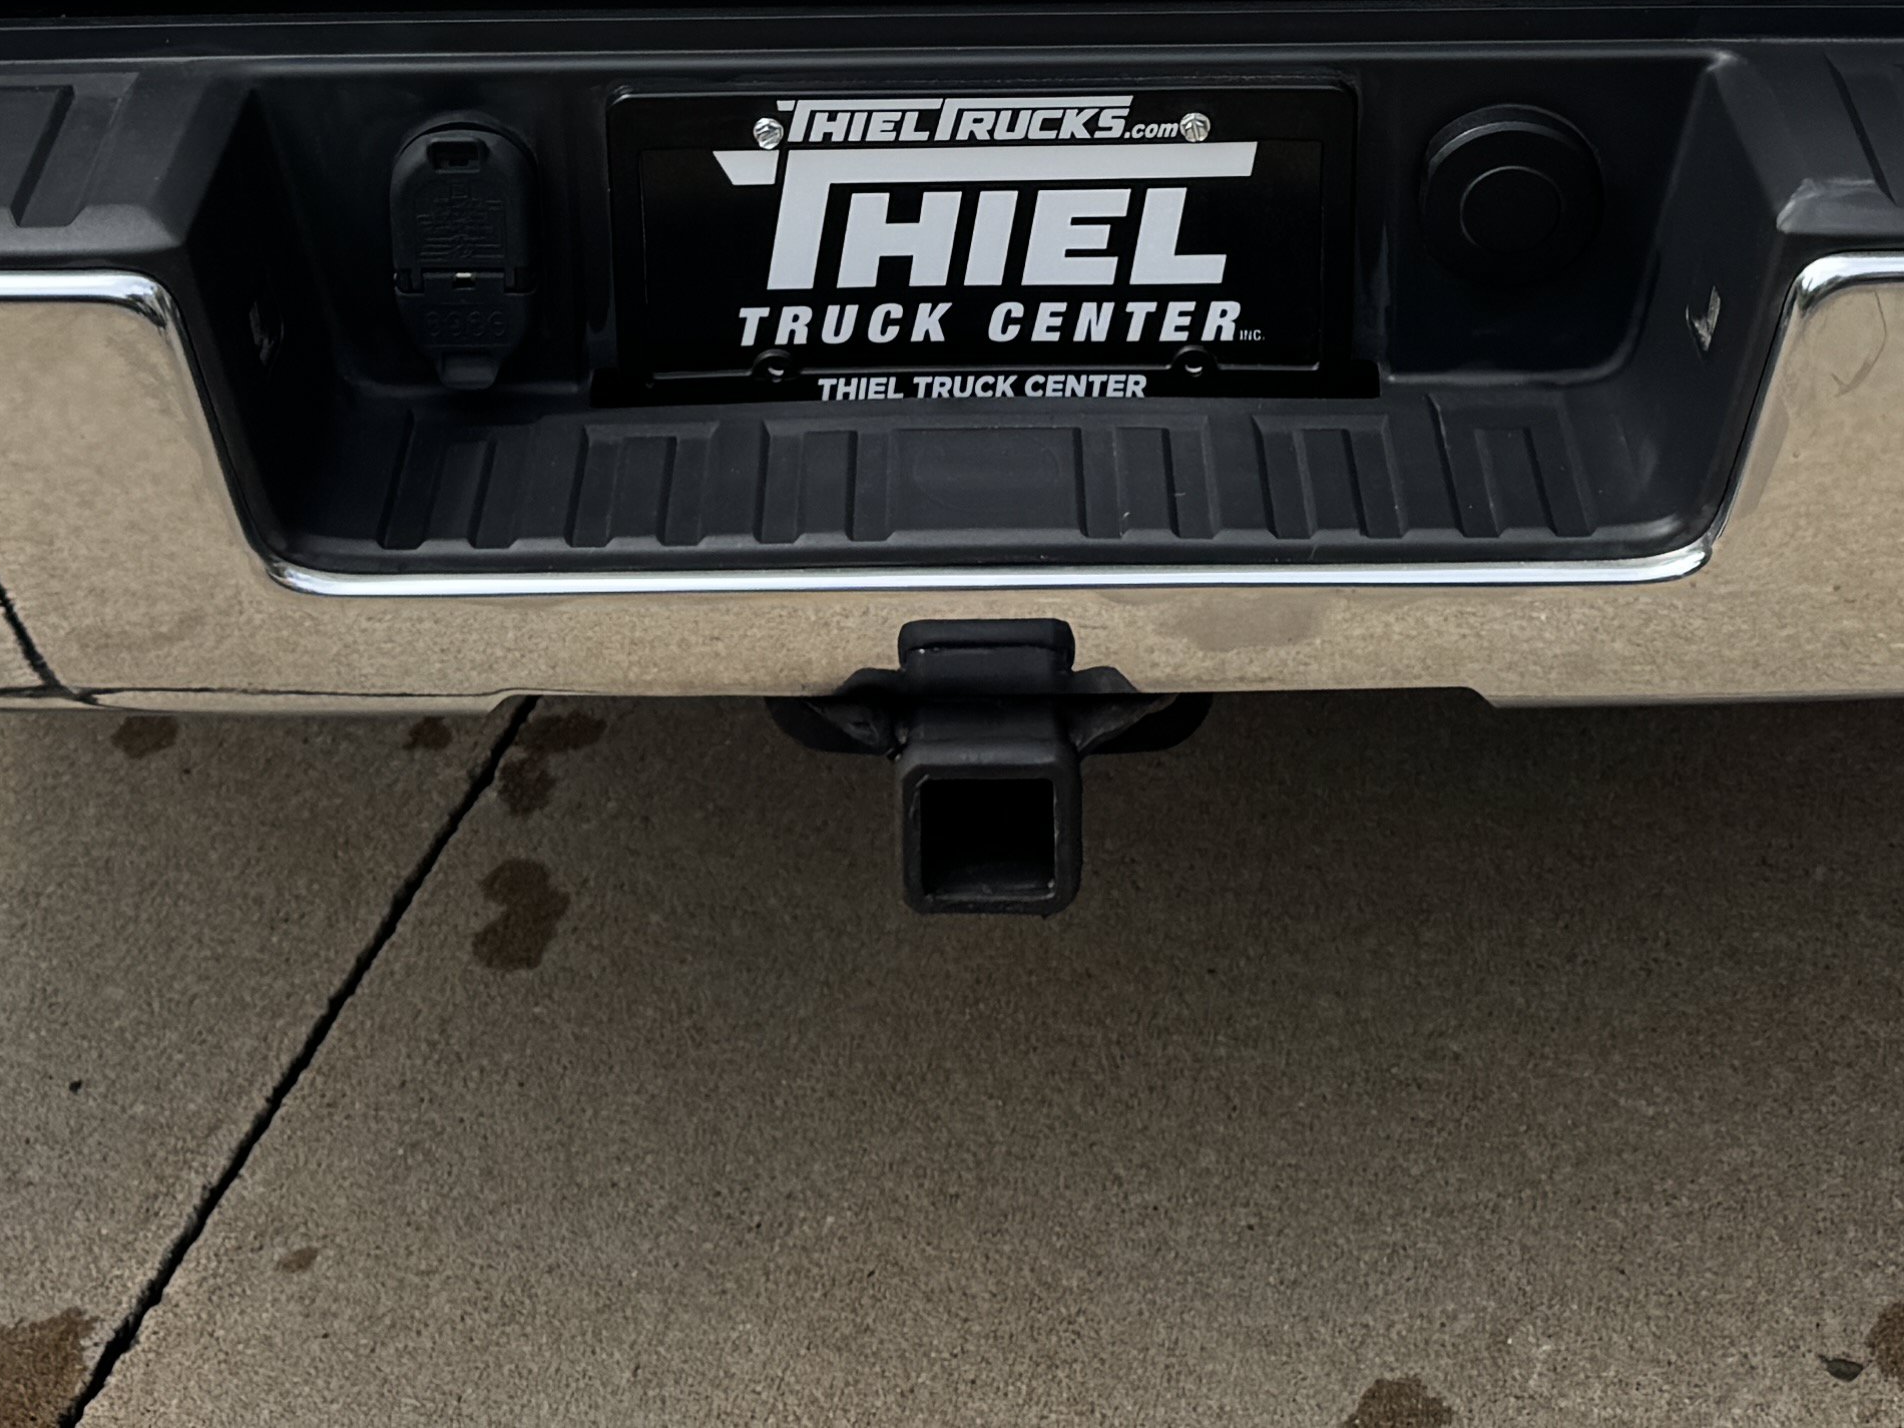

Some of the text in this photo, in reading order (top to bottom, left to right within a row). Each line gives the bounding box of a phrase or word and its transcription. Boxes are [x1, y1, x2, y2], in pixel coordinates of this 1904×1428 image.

[712, 141, 1258, 290] THIEL
[739, 302, 953, 346] TRUCK
[988, 300, 1242, 343] CENTER
[817, 374, 1147, 402] THIEL TRUCK CENTER
